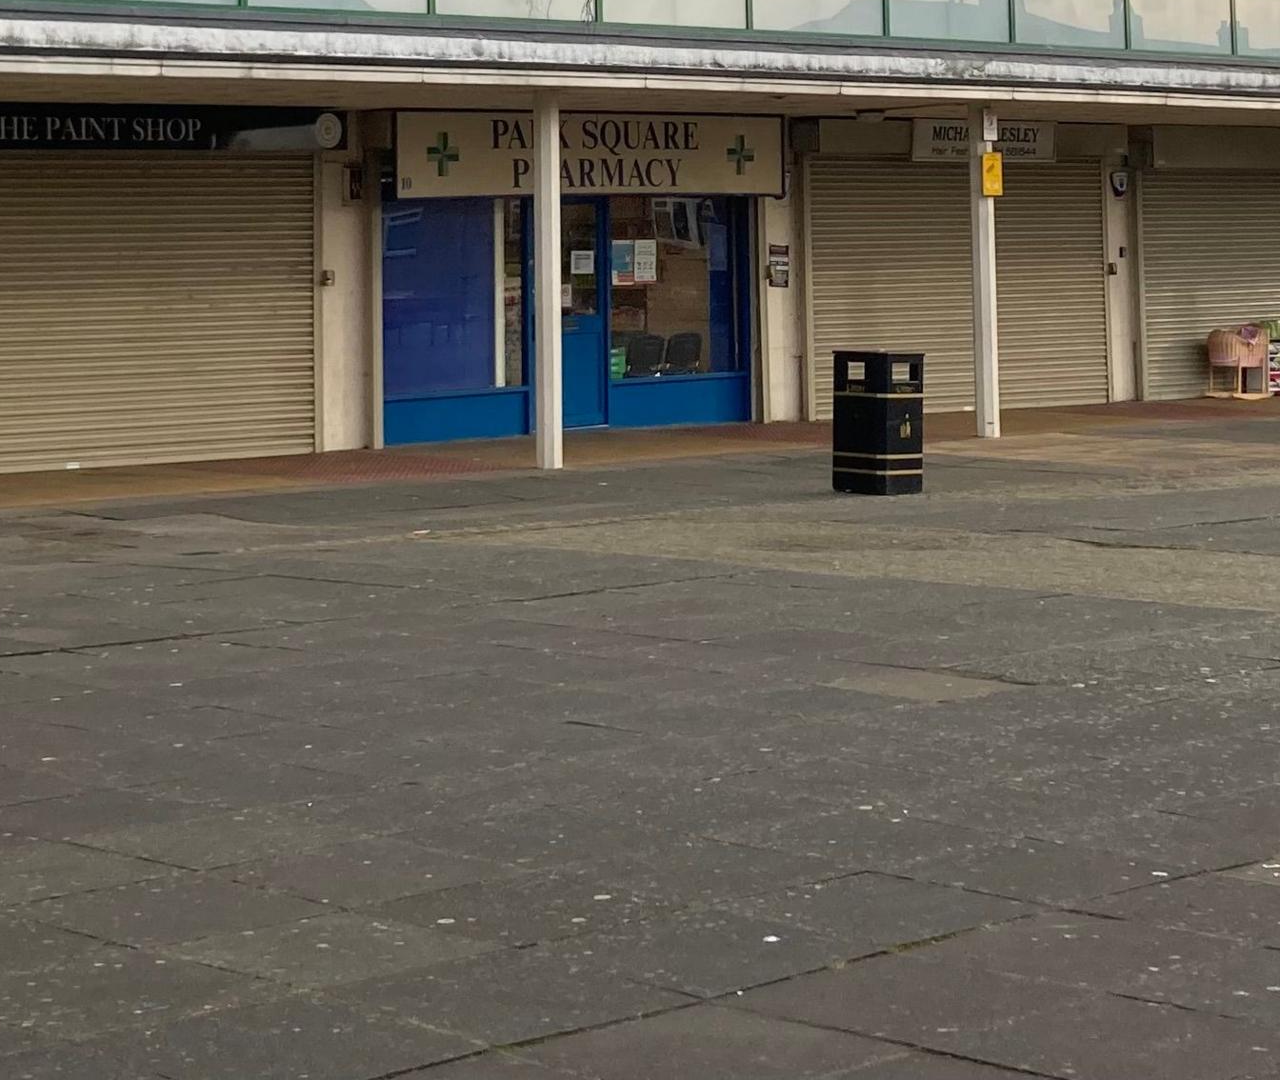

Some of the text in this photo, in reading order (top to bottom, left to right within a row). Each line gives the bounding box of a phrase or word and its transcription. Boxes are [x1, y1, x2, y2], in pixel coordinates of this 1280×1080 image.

[46, 116, 126, 141] PAINT
[132, 118, 202, 142] SHOP
[582, 120, 700, 155] SQUARE
[401, 176, 412, 190] 10
[512, 157, 683, 189] PARMACY
